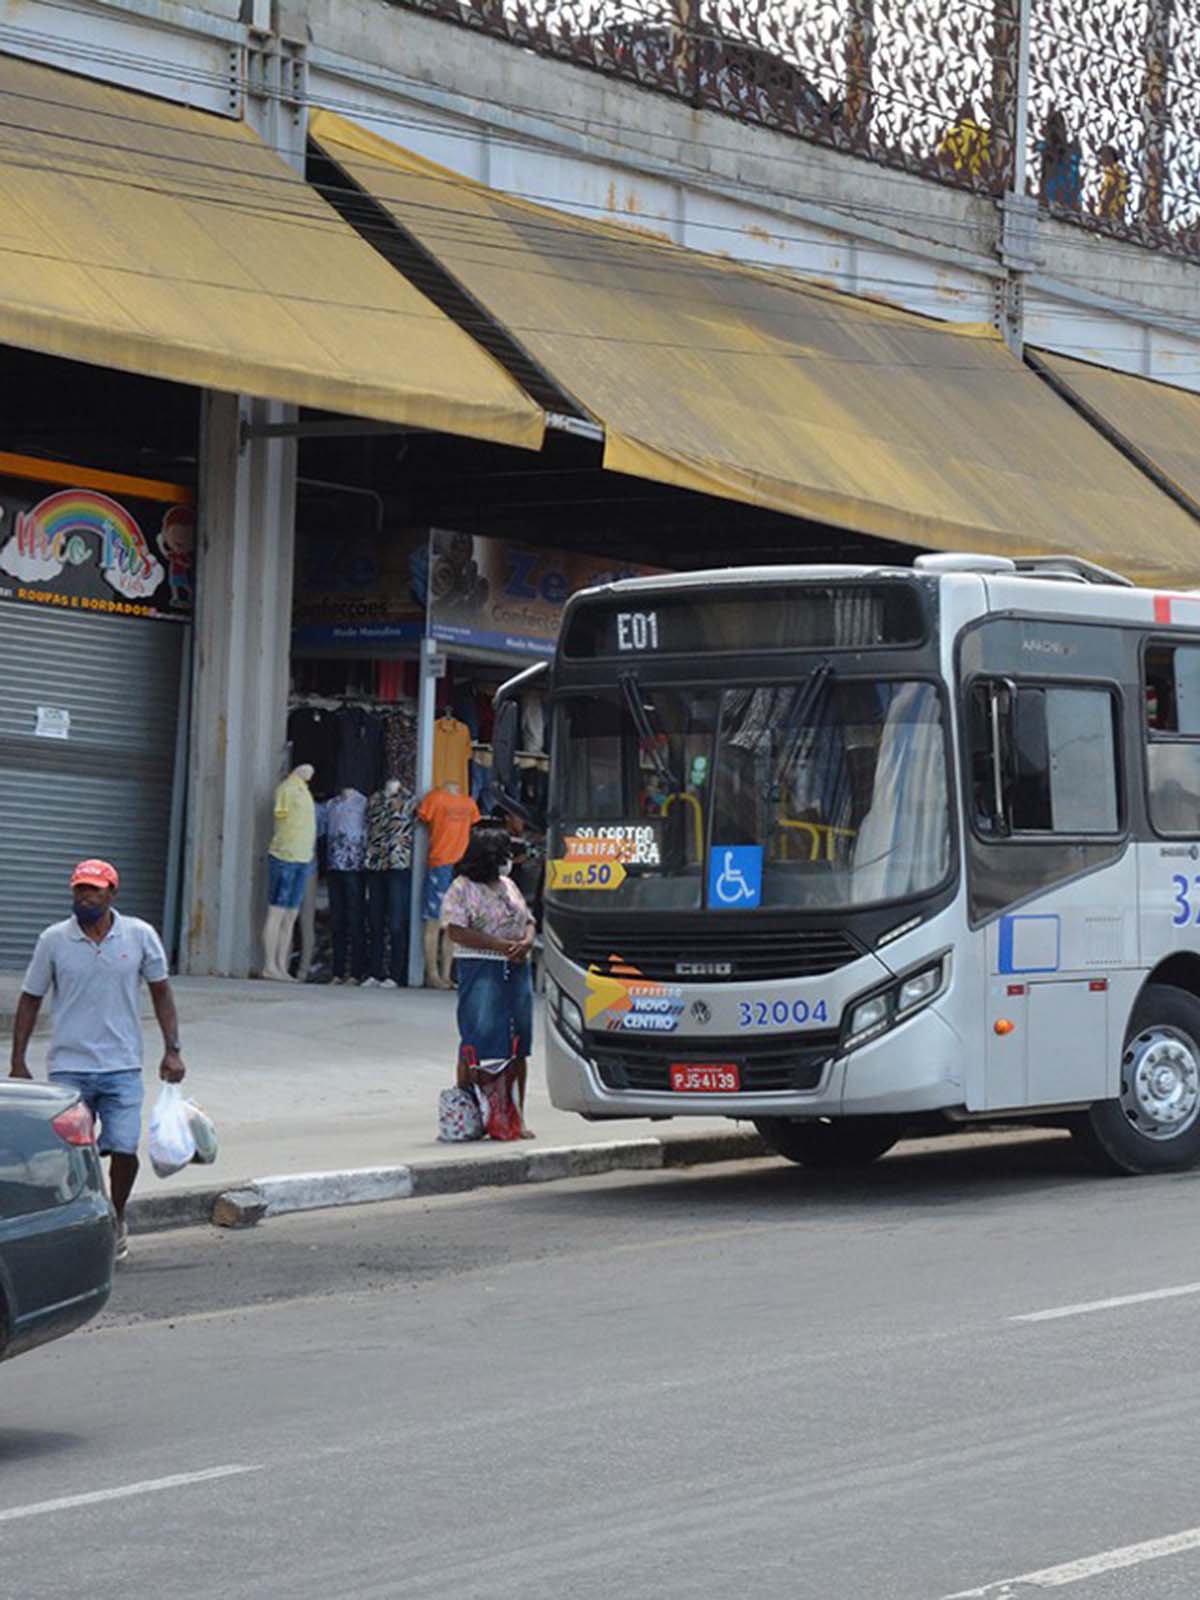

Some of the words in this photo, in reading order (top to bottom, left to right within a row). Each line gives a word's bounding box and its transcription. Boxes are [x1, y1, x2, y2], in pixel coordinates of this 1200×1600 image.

[17, 587, 69, 606] ROUPAS
[70, 597, 80, 608] E
[80, 596, 150, 616] BORDADOS
[617, 612, 658, 649] E01
[570, 842, 616, 857] TARIFA
[575, 863, 612, 885] 0,50
[634, 999, 670, 1012] NOVO
[737, 999, 828, 1027] 32004
[623, 1013, 674, 1030] CENTRO
